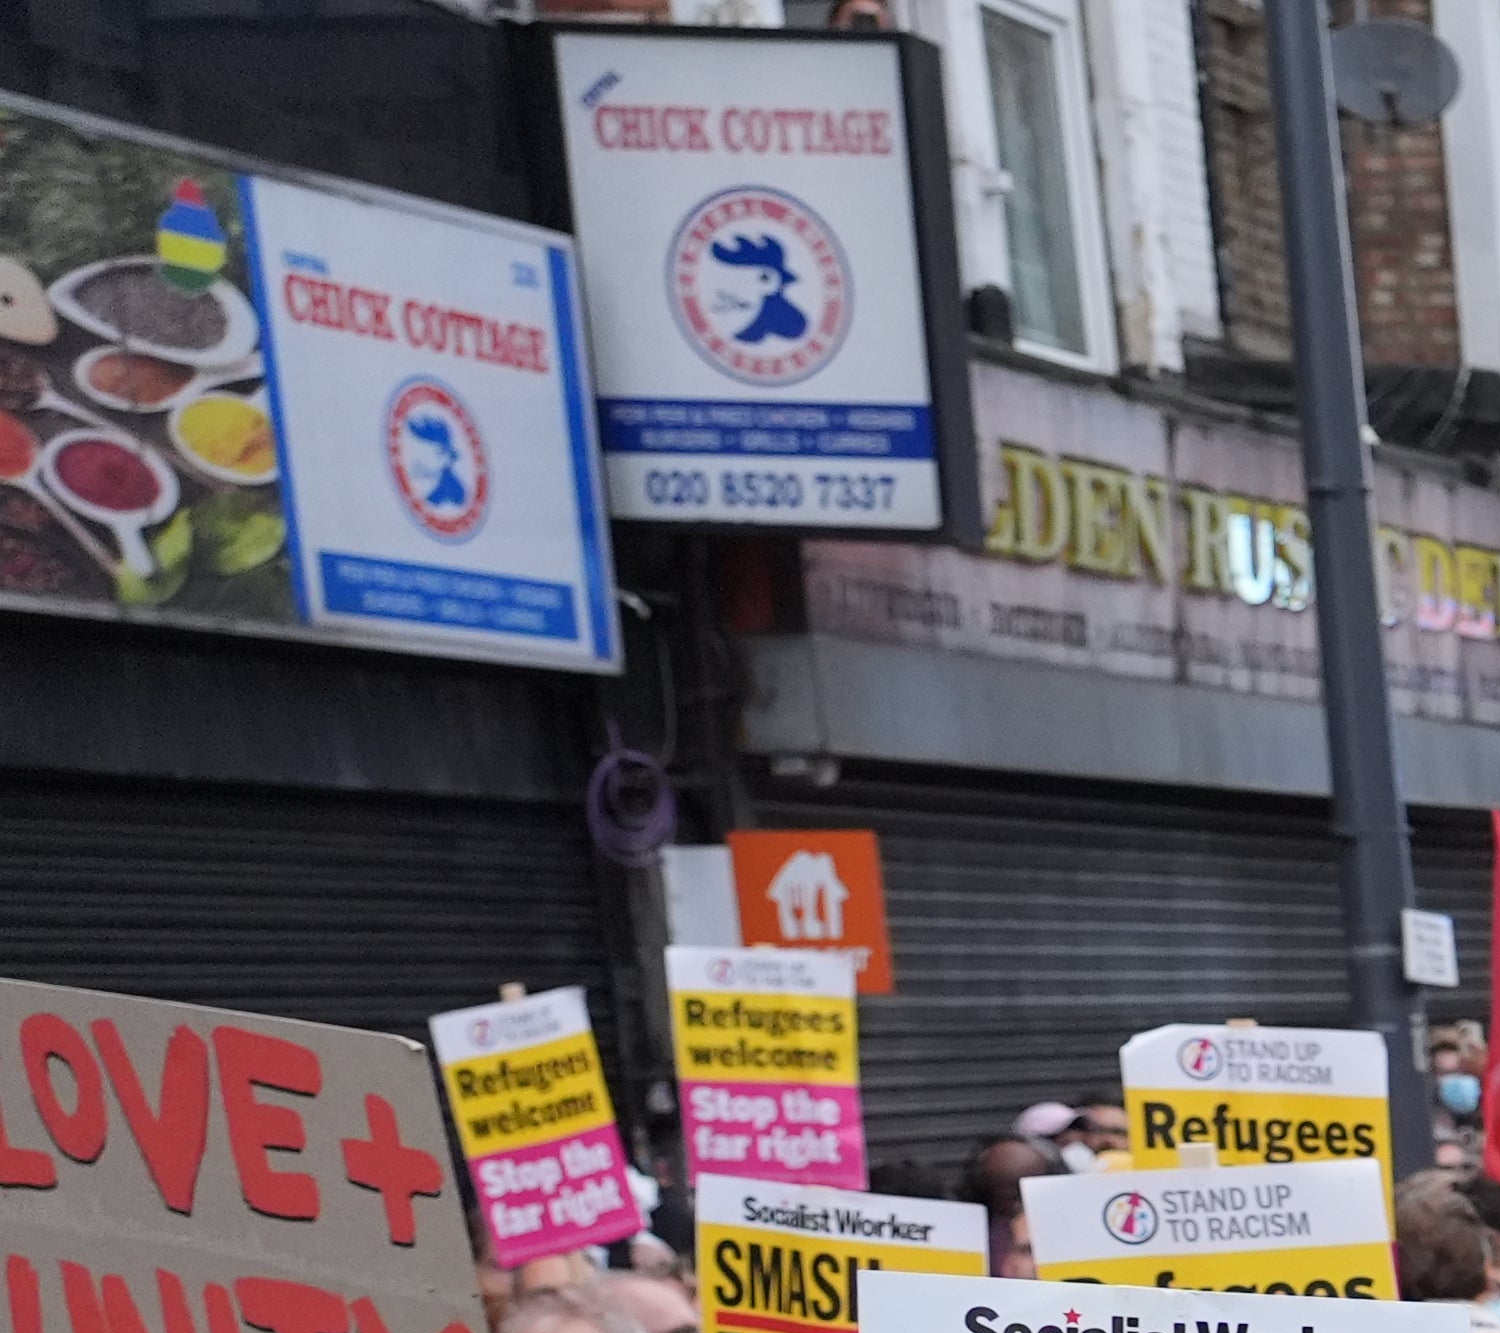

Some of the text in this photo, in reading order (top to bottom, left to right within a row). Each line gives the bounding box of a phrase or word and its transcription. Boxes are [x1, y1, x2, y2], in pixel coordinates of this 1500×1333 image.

[595, 105, 892, 156] CHICK COTTAGE
[284, 273, 550, 374] CHICK COTTAGE
[645, 468, 895, 511] 020 8520 7337
[684, 999, 845, 1037] Refugees
[455, 1049, 591, 1099] Refugees
[690, 1039, 838, 1070] welcome
[470, 1090, 595, 1140] welcome
[691, 1087, 842, 1127] Stop the
[694, 1129, 841, 1169] far right
